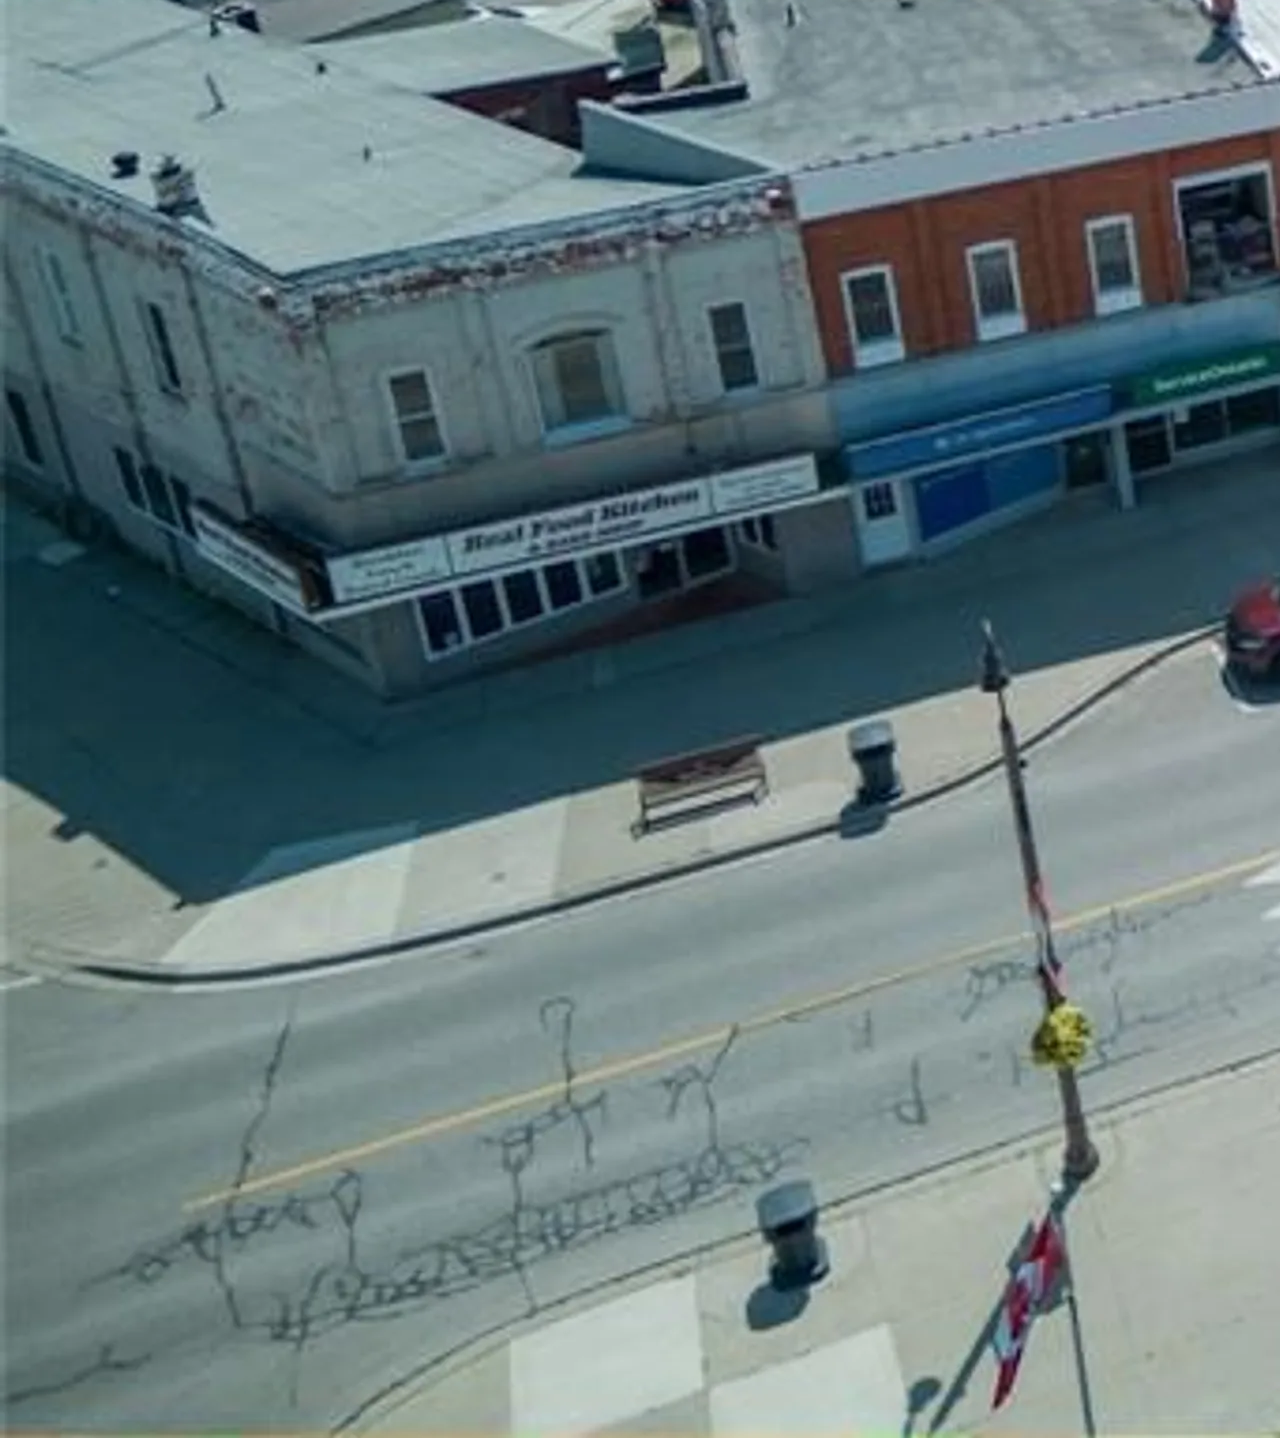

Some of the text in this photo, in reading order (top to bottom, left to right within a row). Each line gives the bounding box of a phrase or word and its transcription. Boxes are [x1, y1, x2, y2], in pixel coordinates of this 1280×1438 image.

[464, 524, 524, 551] Real
[532, 508, 595, 538] Food
[600, 487, 700, 521] Kitchen
